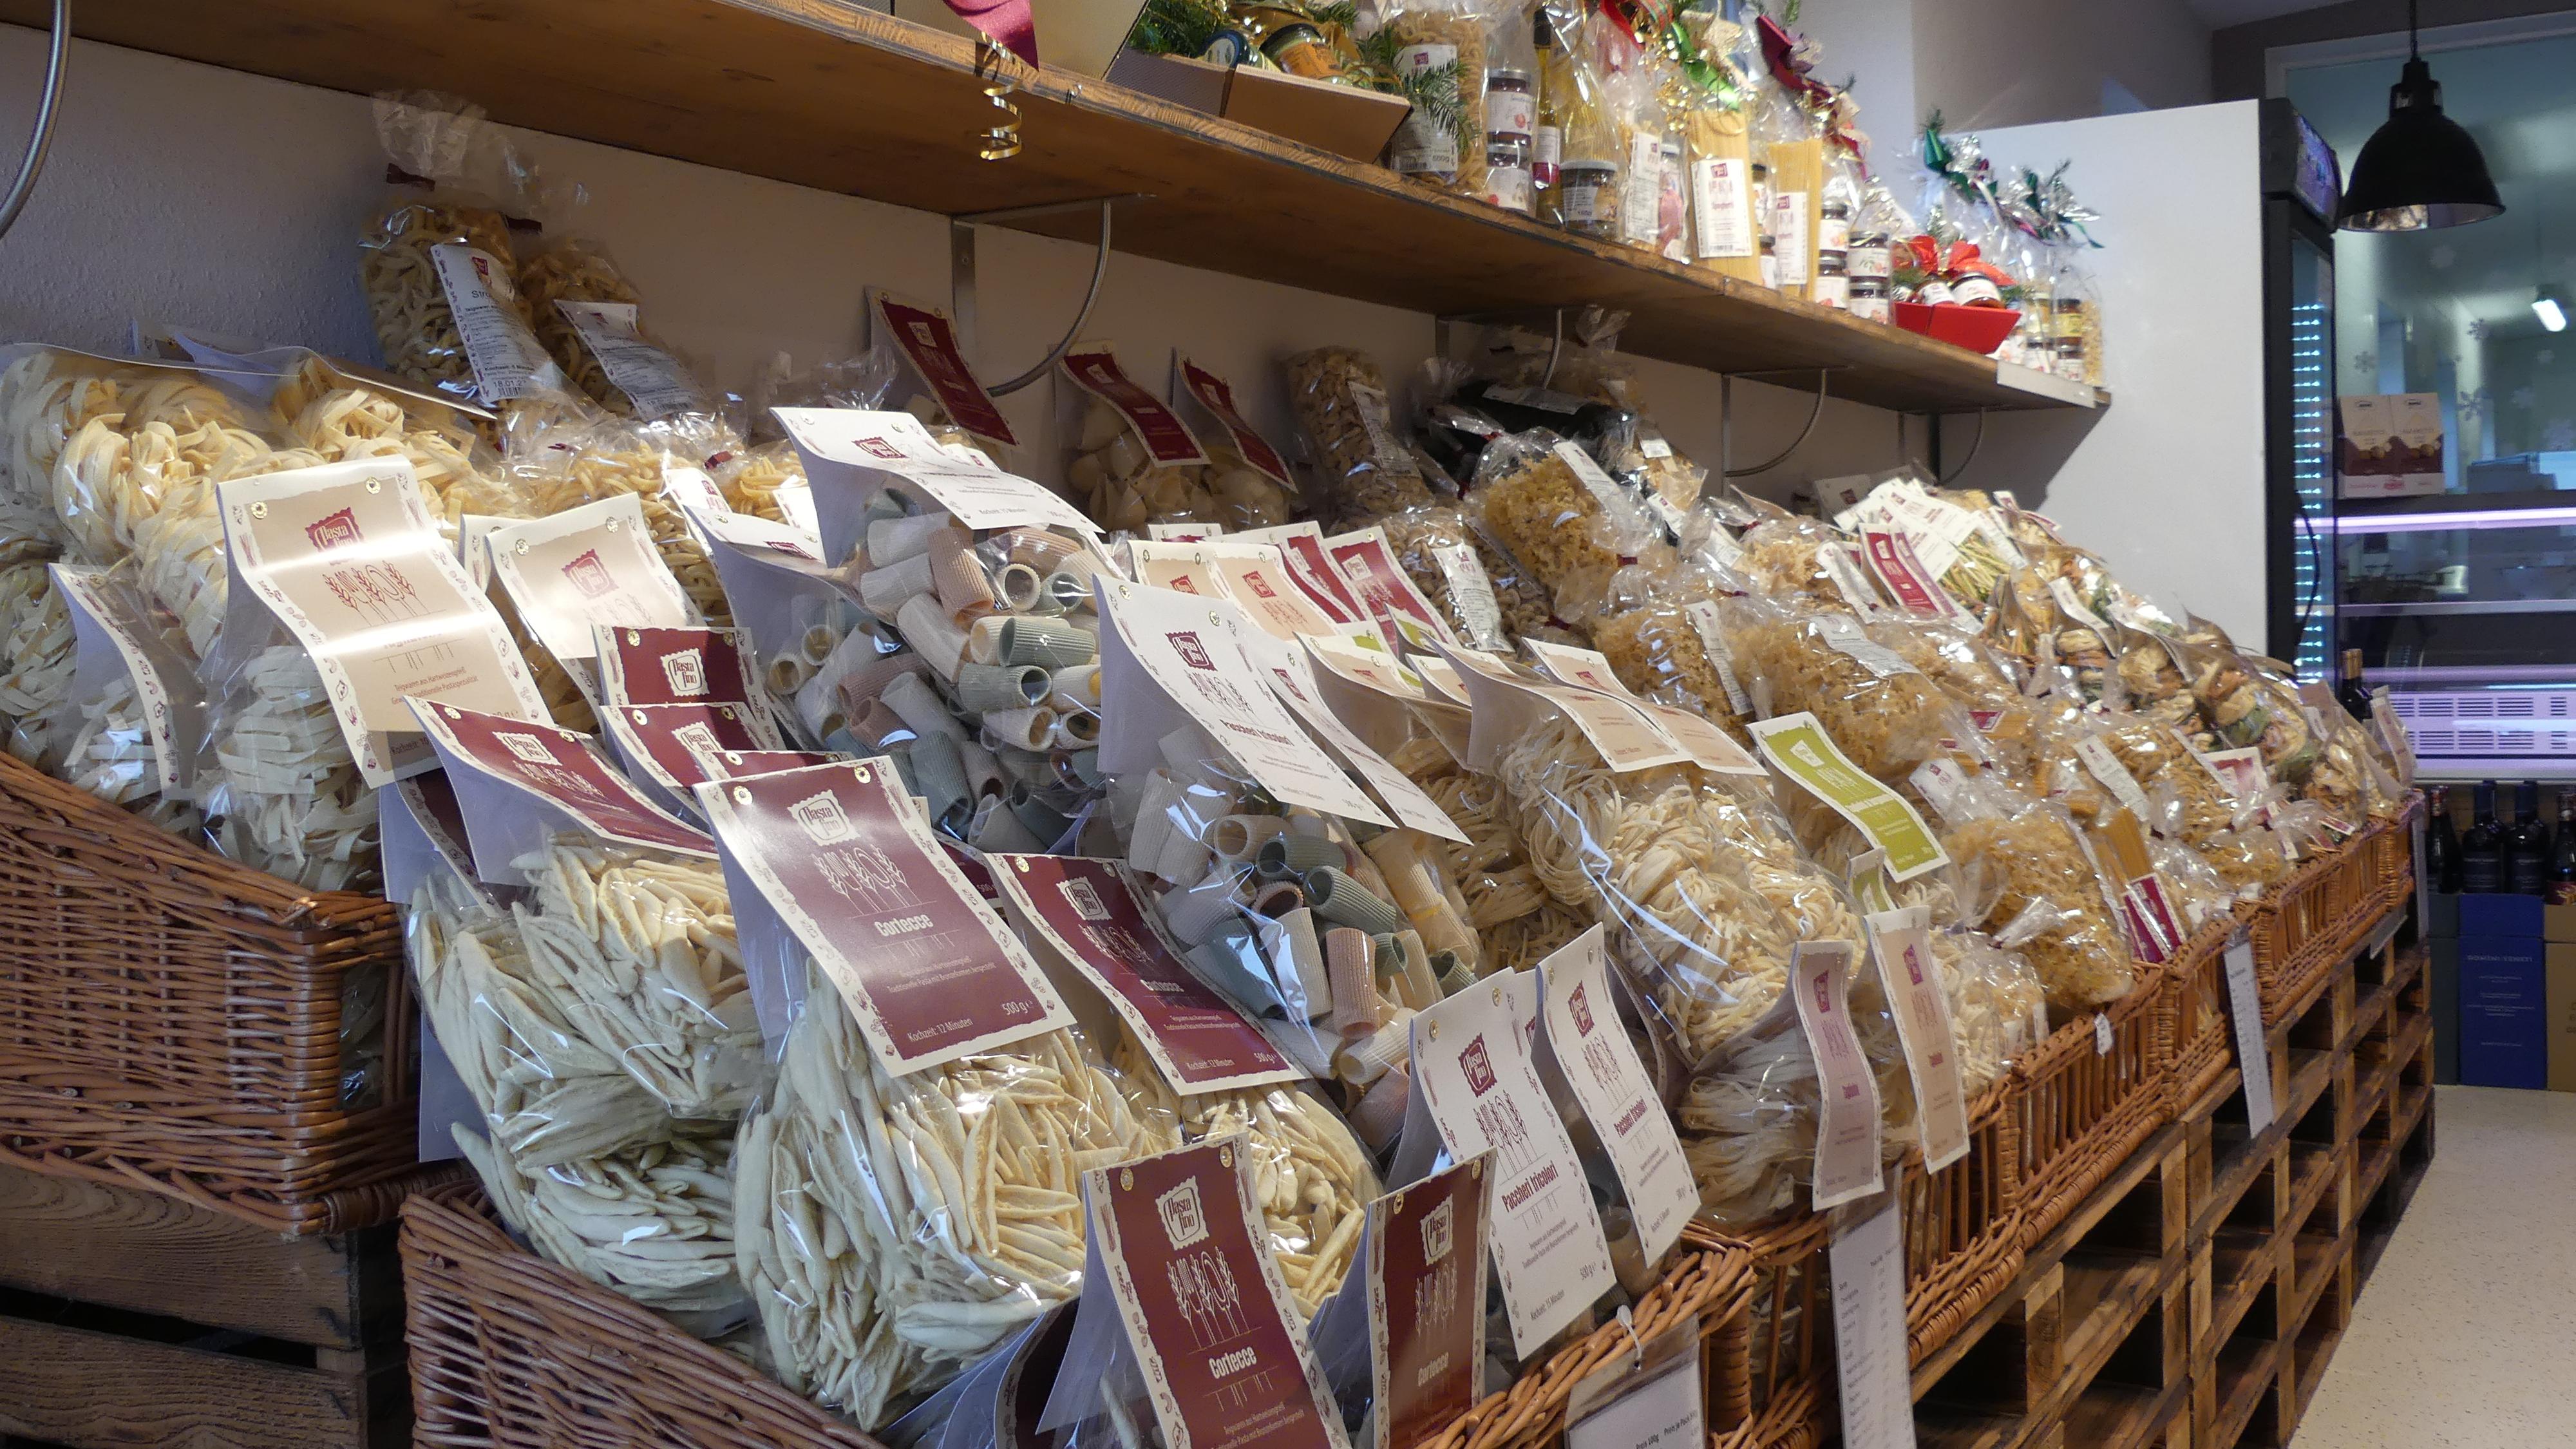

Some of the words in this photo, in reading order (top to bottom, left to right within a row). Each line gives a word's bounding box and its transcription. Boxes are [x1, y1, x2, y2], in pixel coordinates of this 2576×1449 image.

[672, 658, 694, 676] Pasta
[682, 672, 697, 688] fino
[683, 732, 708, 746] Pasta
[802, 806, 834, 825] Pasta
[874, 914, 934, 936] Cortecce
[1001, 1001, 1019, 1016] 500
[1501, 1178, 1534, 1213] Paccheri
[1530, 1160, 1558, 1192] tricolori
[1168, 1197, 1191, 1222] Pasta
[1179, 1212, 1195, 1236] fino
[1208, 1346, 1257, 1379] Cortecce
